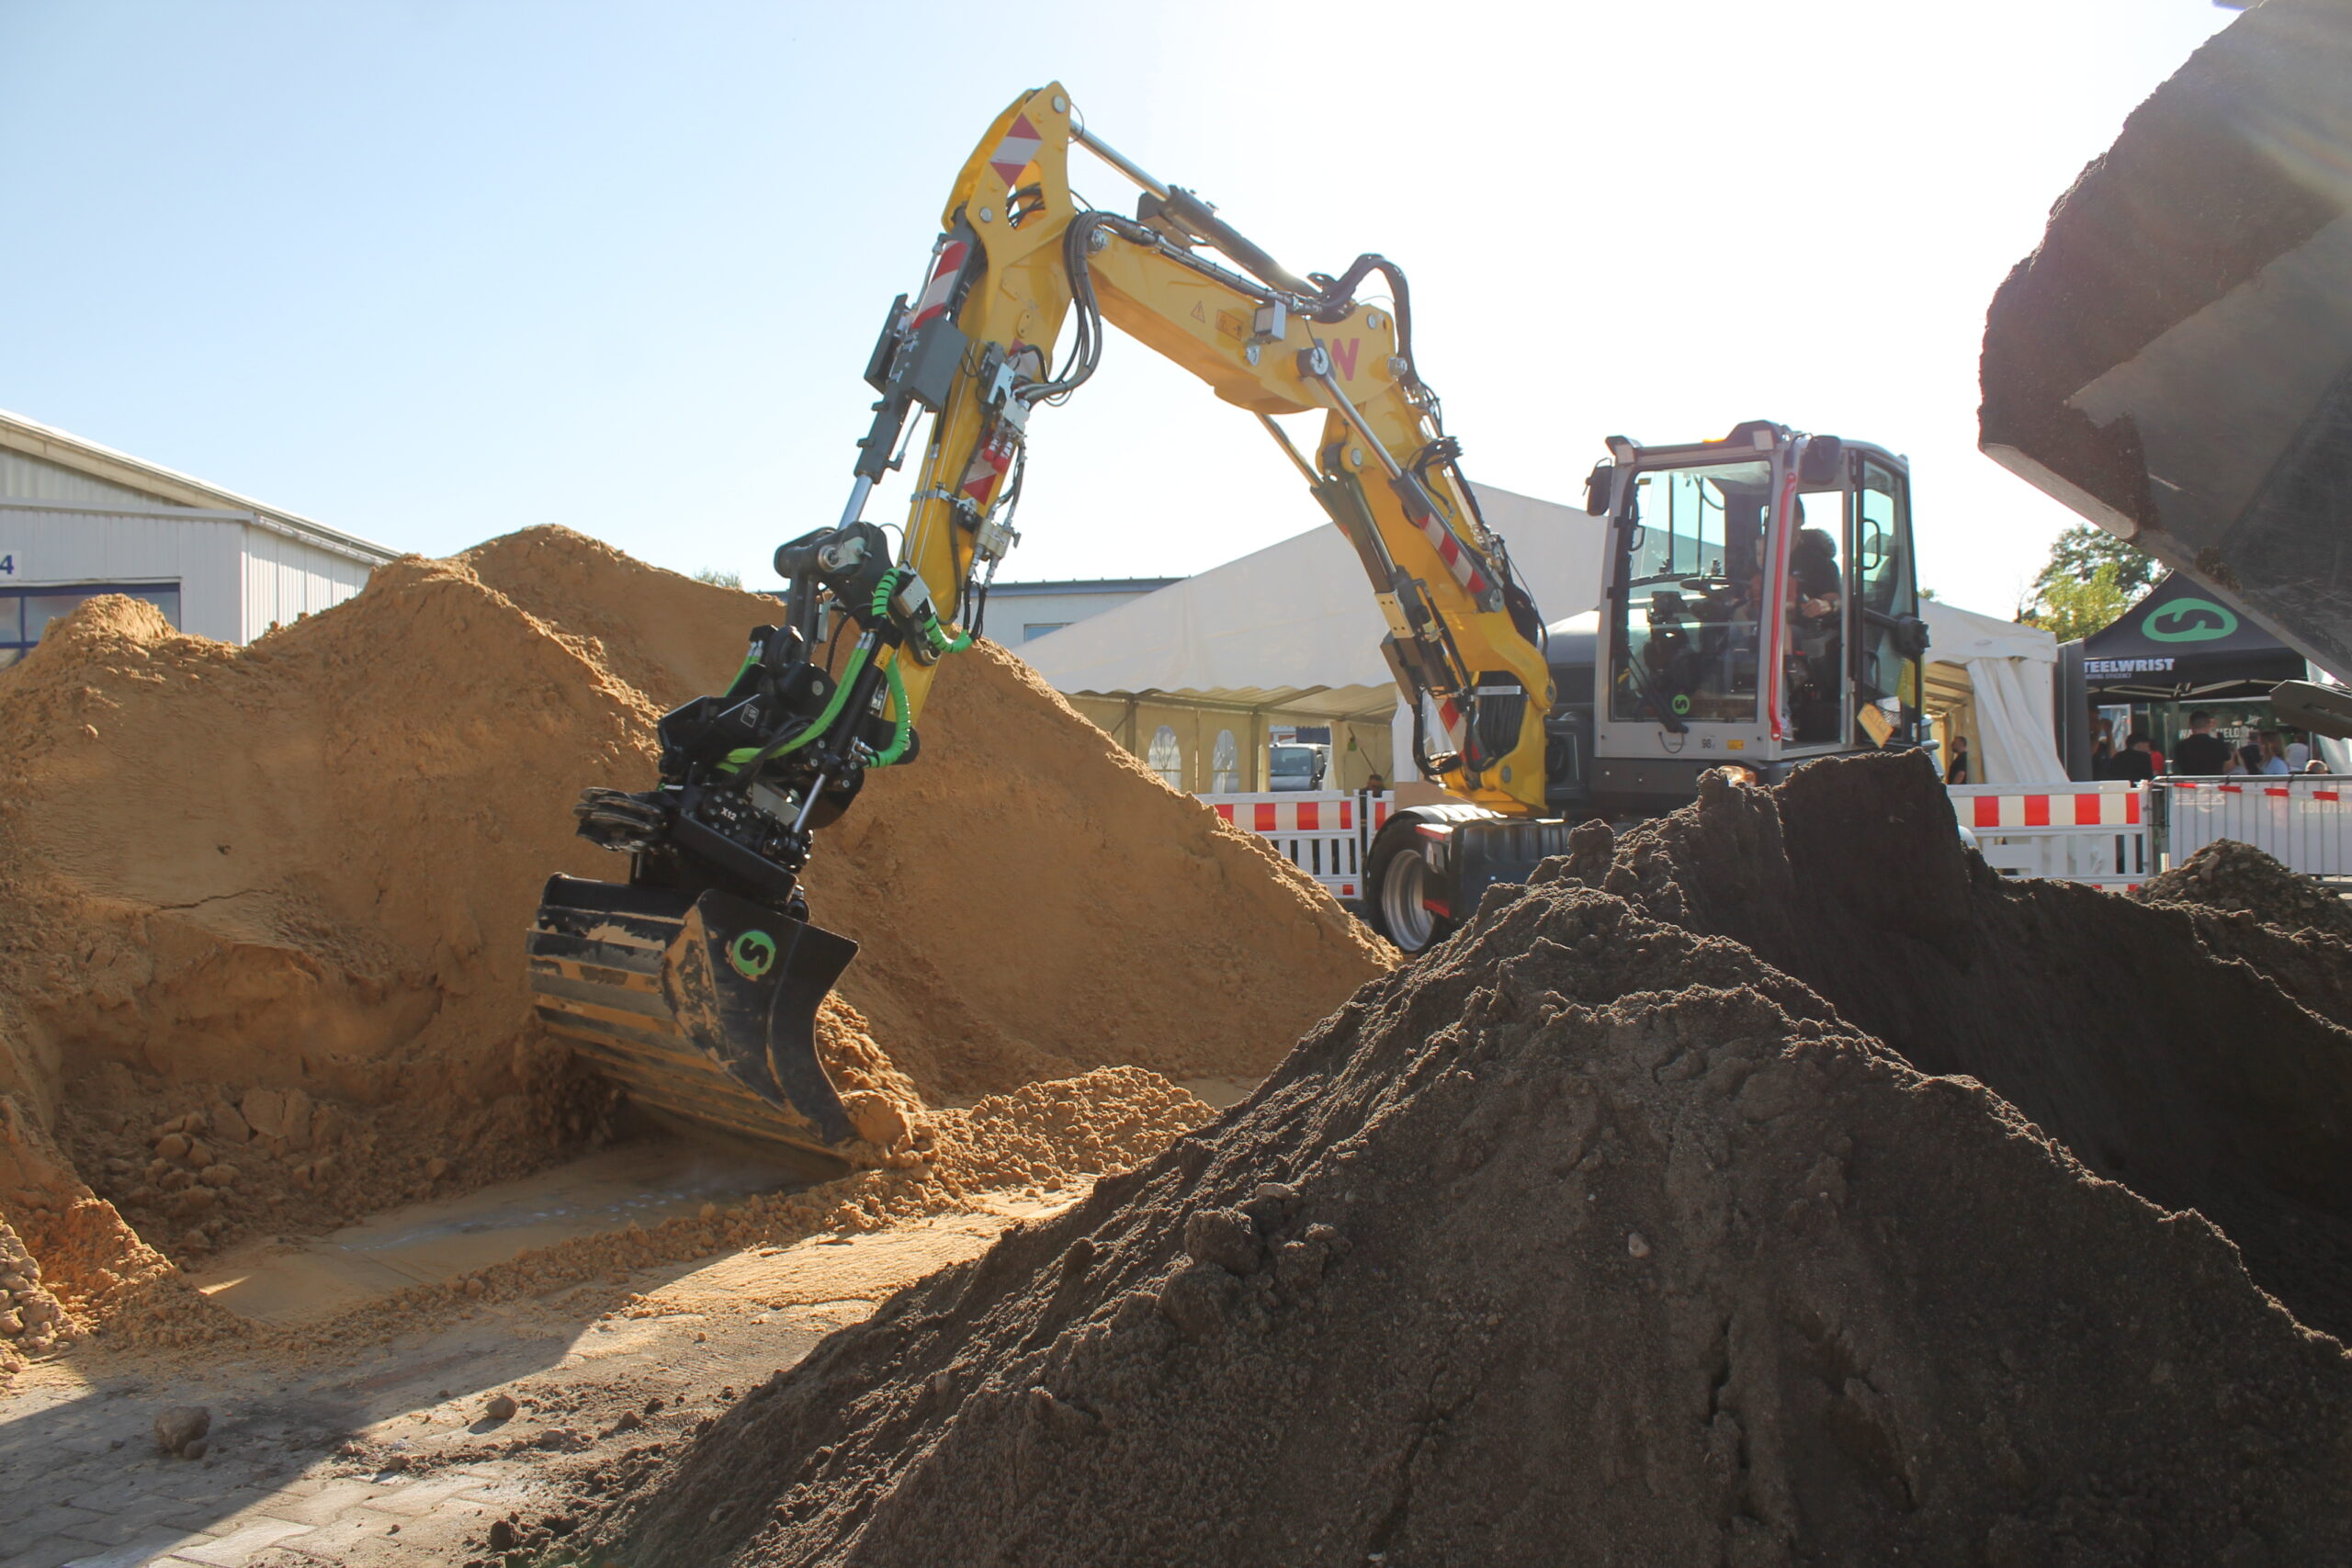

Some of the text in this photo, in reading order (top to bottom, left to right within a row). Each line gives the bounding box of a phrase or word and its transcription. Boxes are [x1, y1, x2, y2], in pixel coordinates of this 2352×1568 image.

[0, 555, 15, 575] 4
[2084, 658, 2175, 672] TEELWRIST
[721, 807, 737, 821] X12
